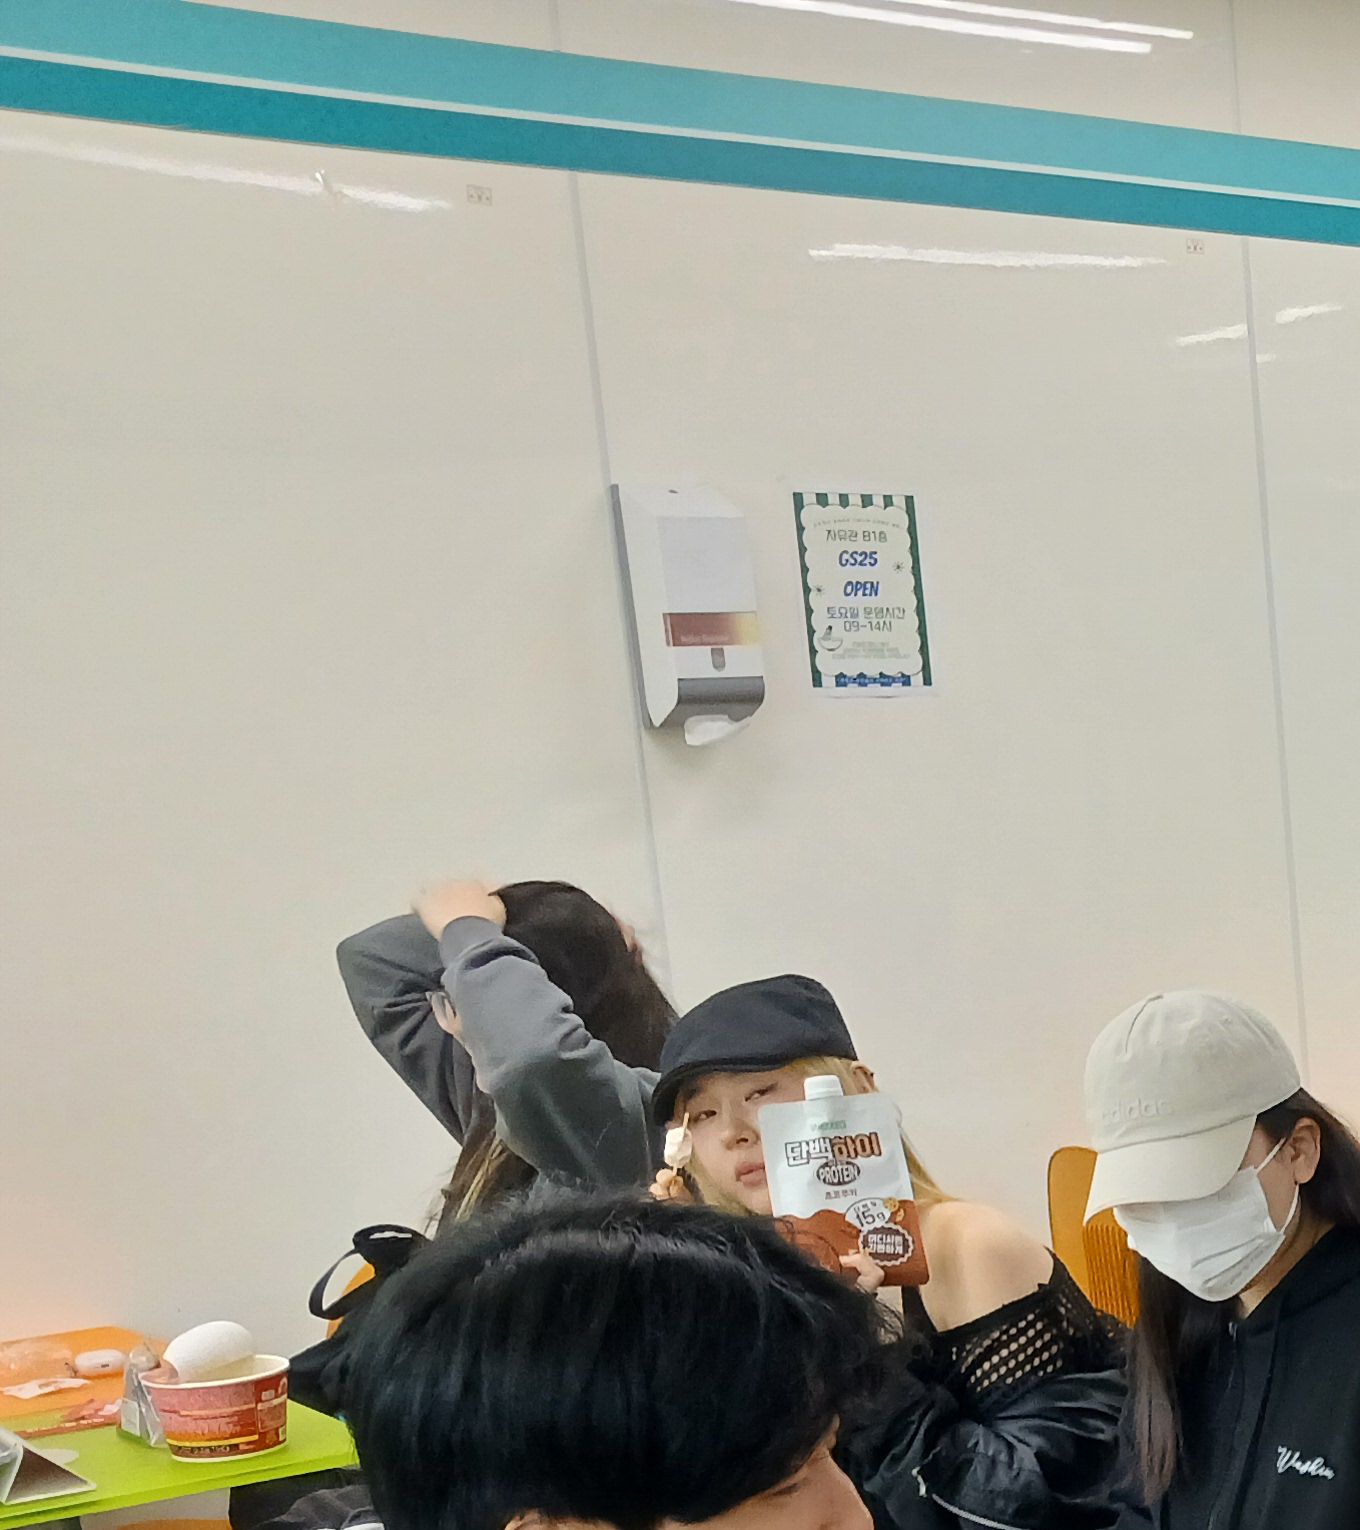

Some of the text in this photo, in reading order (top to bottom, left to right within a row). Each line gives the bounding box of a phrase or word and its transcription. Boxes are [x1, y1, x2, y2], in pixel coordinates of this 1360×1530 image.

[838, 550, 878, 567] GS25
[843, 580, 880, 597] OPEN
[826, 606, 859, 619] 토요일
[843, 620, 893, 633] 09-14시
[785, 1132, 882, 1167] 단백하이
[818, 1165, 860, 1184] PROTEIN
